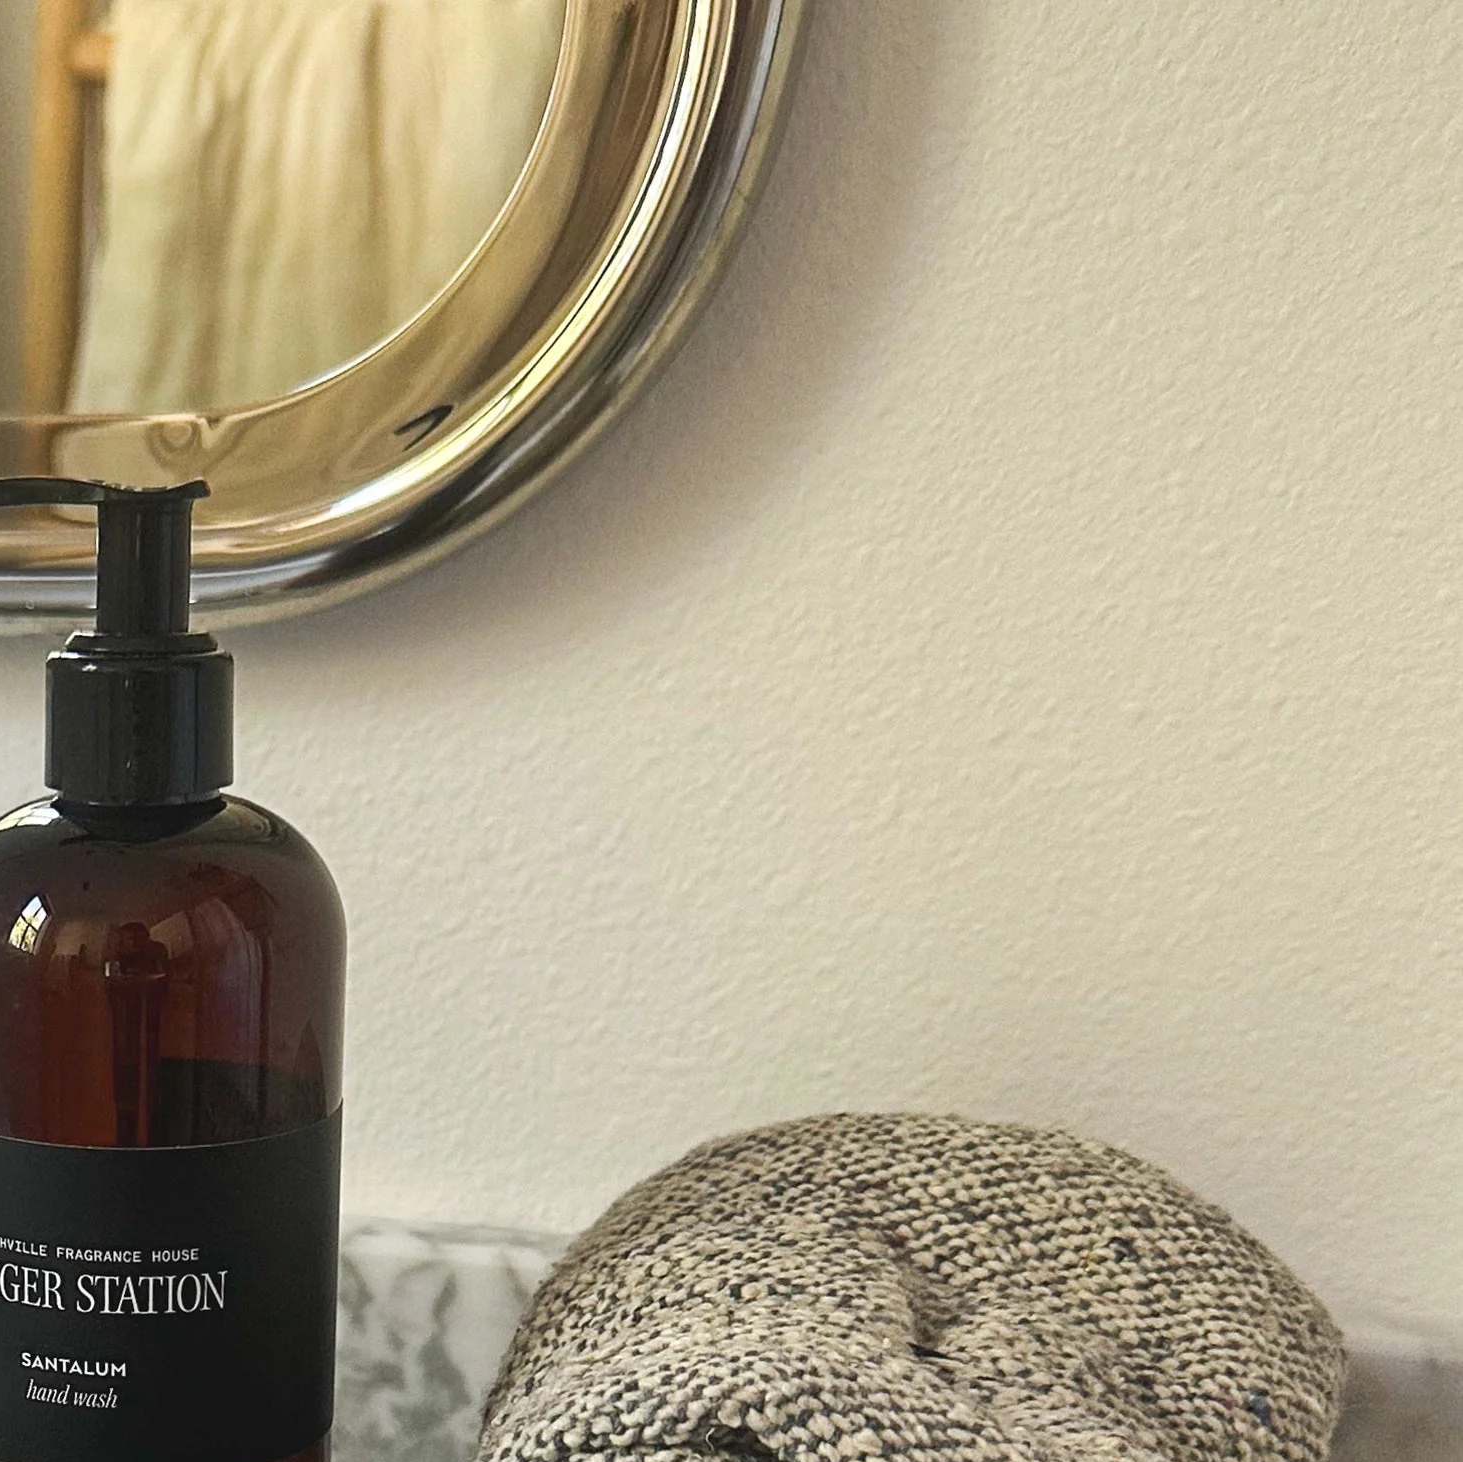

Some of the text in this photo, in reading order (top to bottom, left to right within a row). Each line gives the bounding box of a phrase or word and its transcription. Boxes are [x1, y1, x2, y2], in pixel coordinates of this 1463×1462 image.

[56, 1247, 142, 1263] FRAGRANCE
[152, 1248, 199, 1263] HOUSE
[76, 1270, 229, 1315] STATION
[22, 1352, 127, 1377] SANTALUM
[26, 1378, 119, 1409] hand wash
